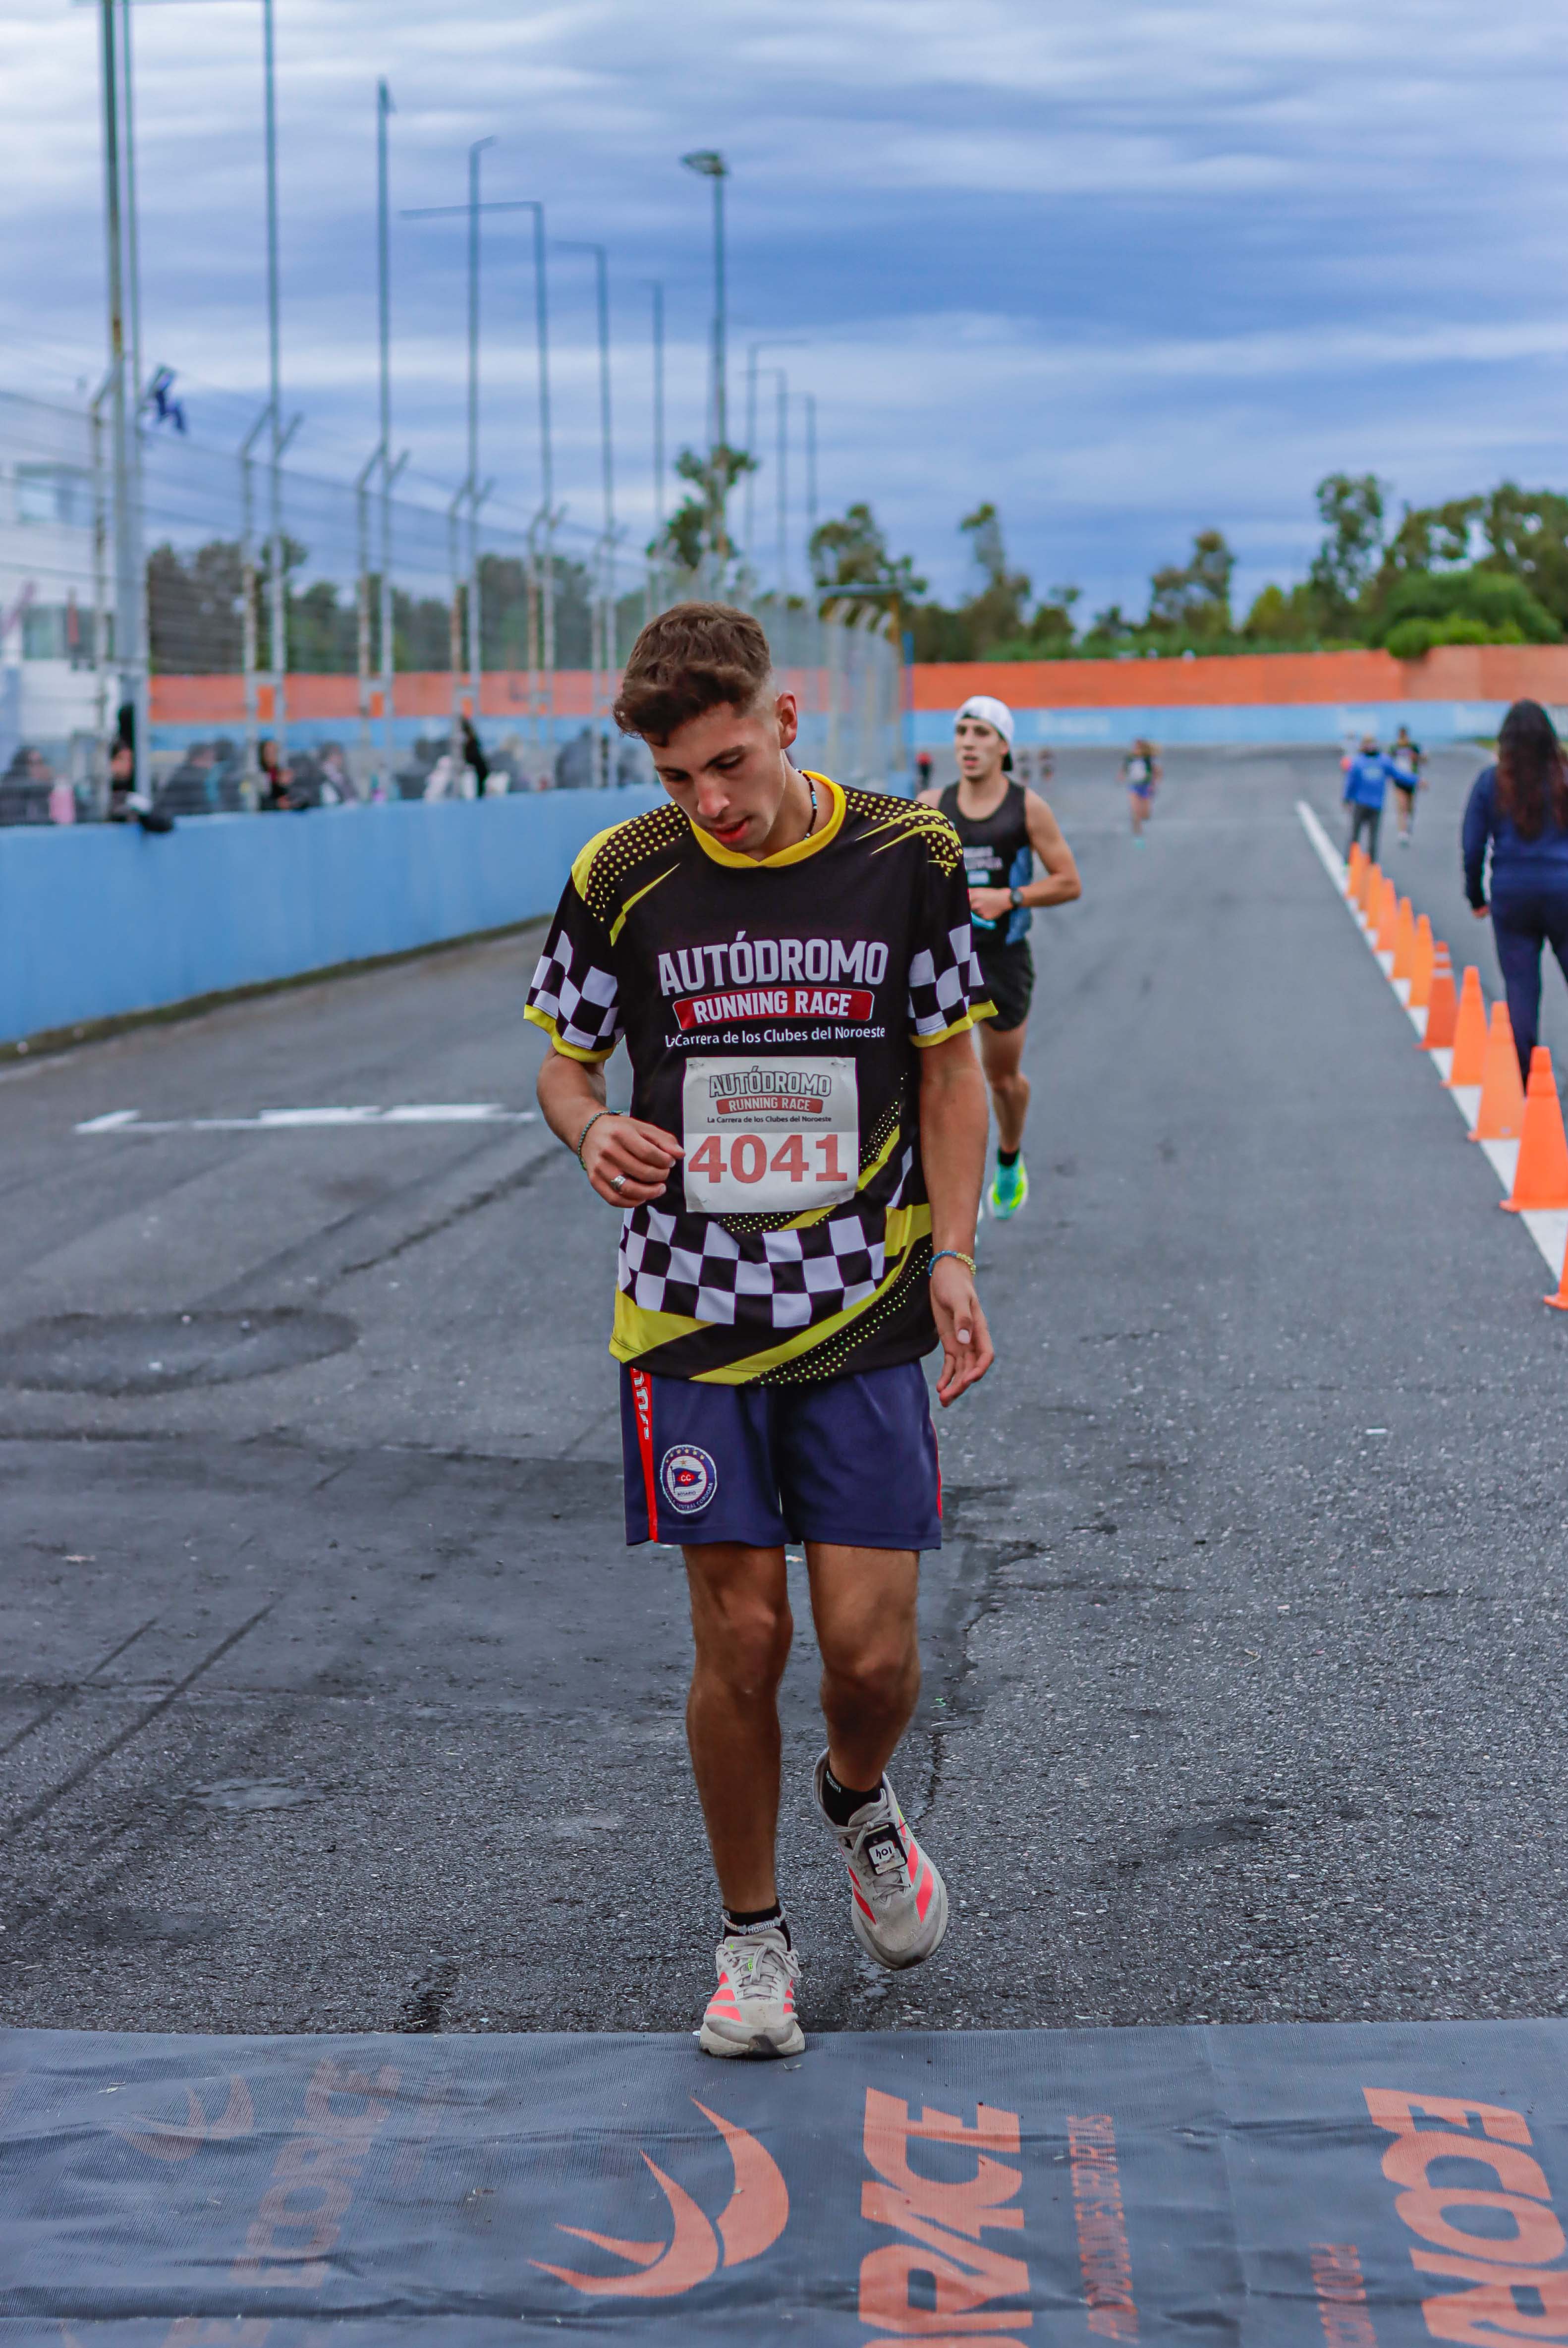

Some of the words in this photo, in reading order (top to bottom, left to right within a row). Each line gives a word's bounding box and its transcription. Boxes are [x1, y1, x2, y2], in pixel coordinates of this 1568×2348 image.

[658, 930, 889, 996] AUTÓDROMO
[693, 991, 788, 1023] RUNNING
[795, 991, 852, 1016] RACE
[675, 1034, 720, 1047] Carrera
[723, 1030, 739, 1043] de
[742, 1030, 761, 1043] los
[764, 1028, 808, 1042] Clubes
[811, 1026, 832, 1040] del
[835, 1026, 885, 1039] Noroeste
[709, 1065, 832, 1098] AUTÓDROMO
[728, 1097, 778, 1112] RUNNING
[782, 1098, 810, 1111] RACE
[688, 1134, 847, 1183] 4041
[859, 2086, 1034, 2348] RACE
